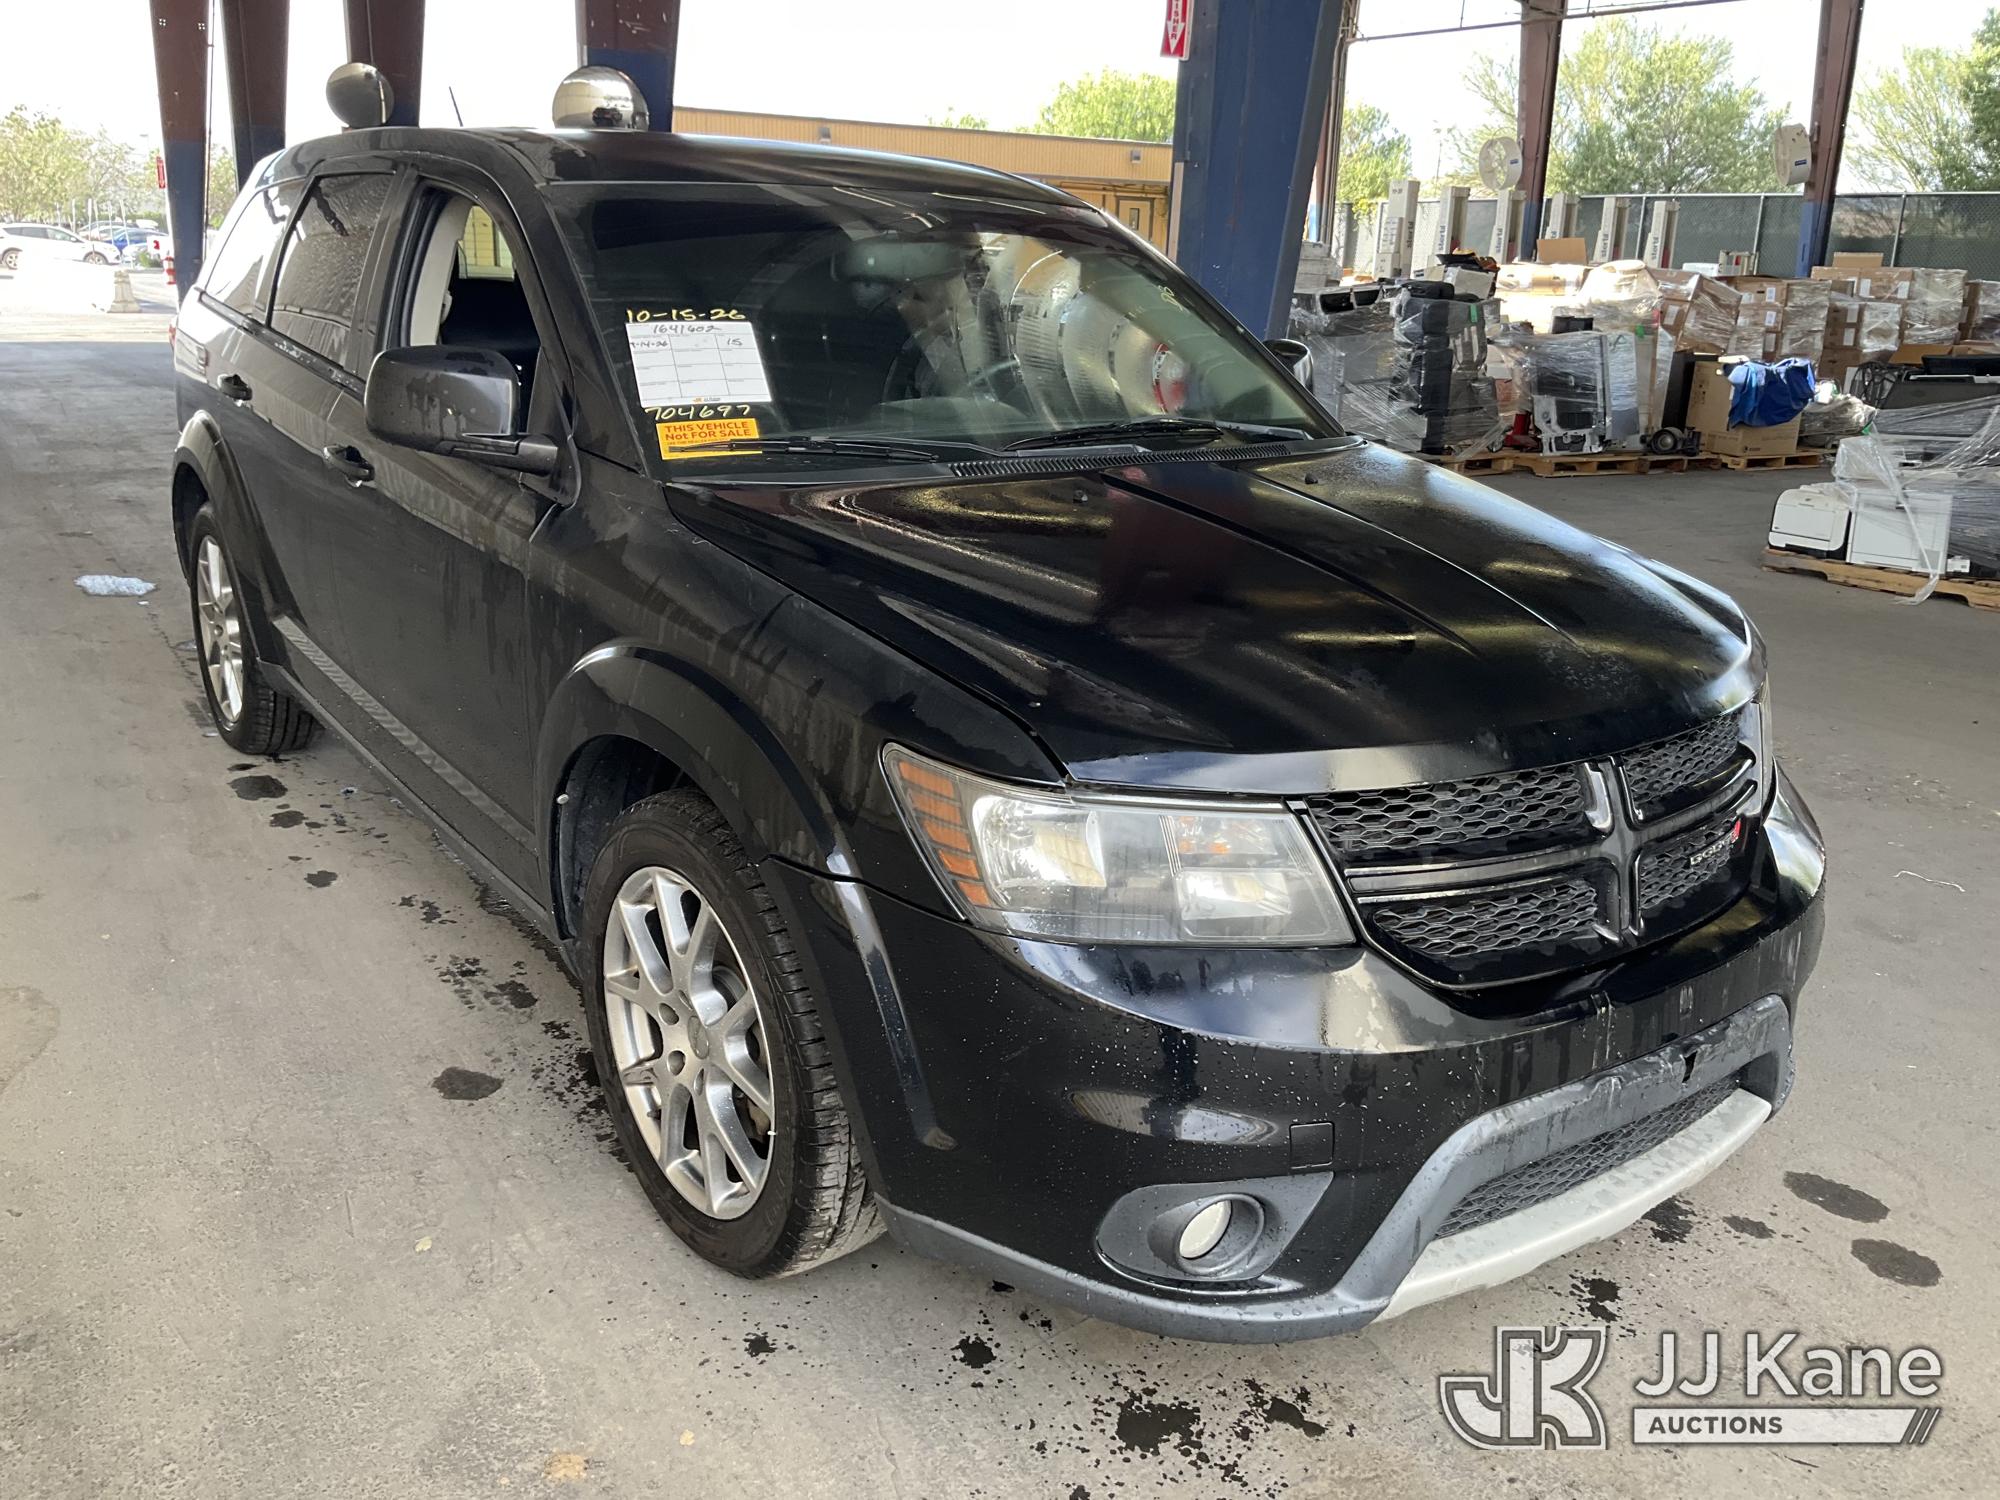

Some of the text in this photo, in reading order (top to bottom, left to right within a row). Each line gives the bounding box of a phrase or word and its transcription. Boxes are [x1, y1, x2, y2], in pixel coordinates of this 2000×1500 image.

[1171, 0, 1180, 39] ISHER
[645, 405, 750, 420] 704697
[665, 421, 749, 433] THIS VEHICLE
[665, 428, 751, 441] Not FOR SALE
